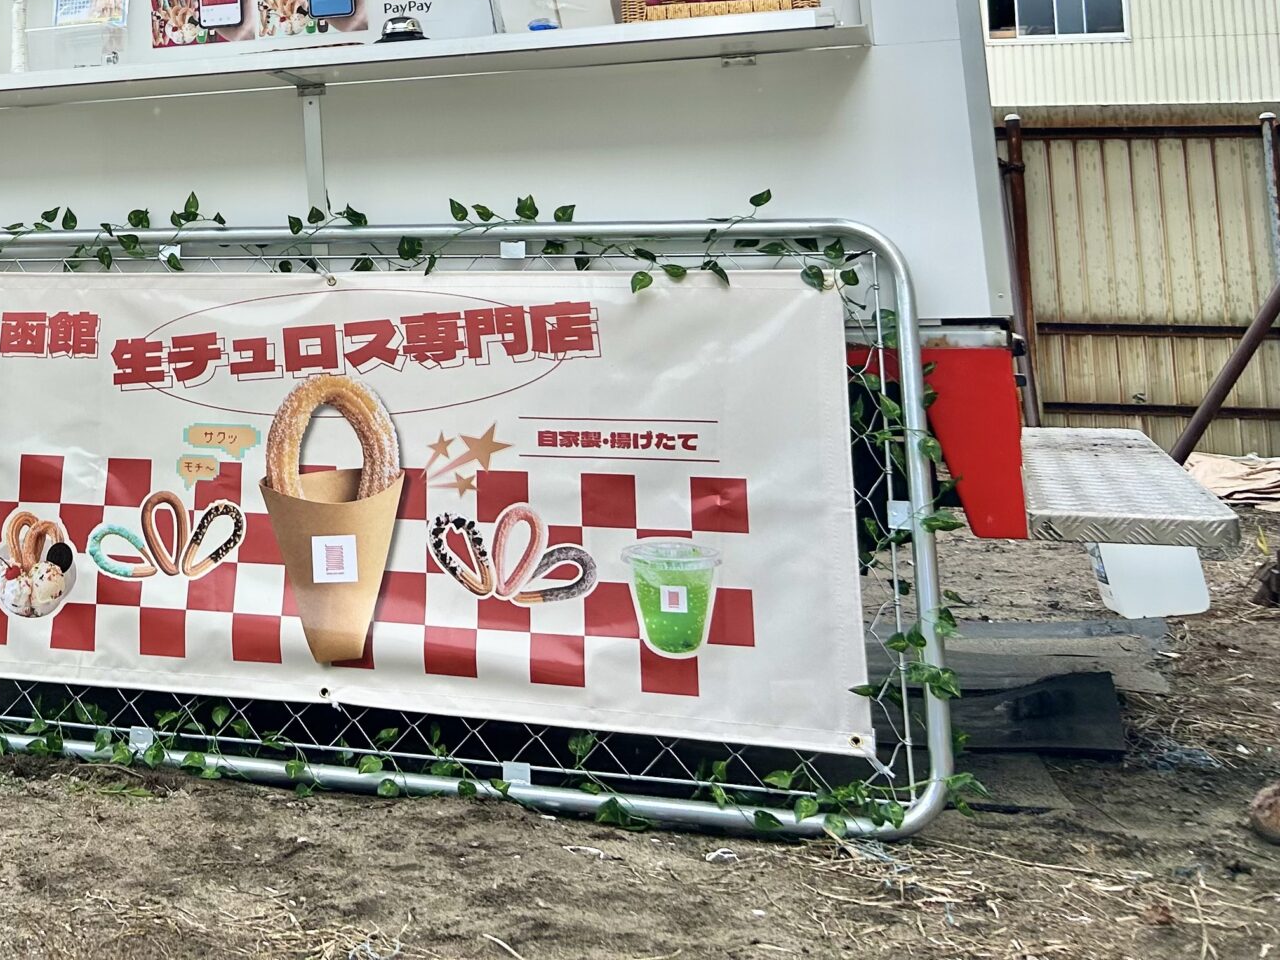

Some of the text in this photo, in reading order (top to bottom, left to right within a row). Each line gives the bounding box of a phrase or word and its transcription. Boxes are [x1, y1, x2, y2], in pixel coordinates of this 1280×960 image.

[384, 1, 432, 16] PayPay
[0, 301, 601, 391] 函館 生チュロス専門店
[537, 430, 698, 451] 自家製・揚げたて
